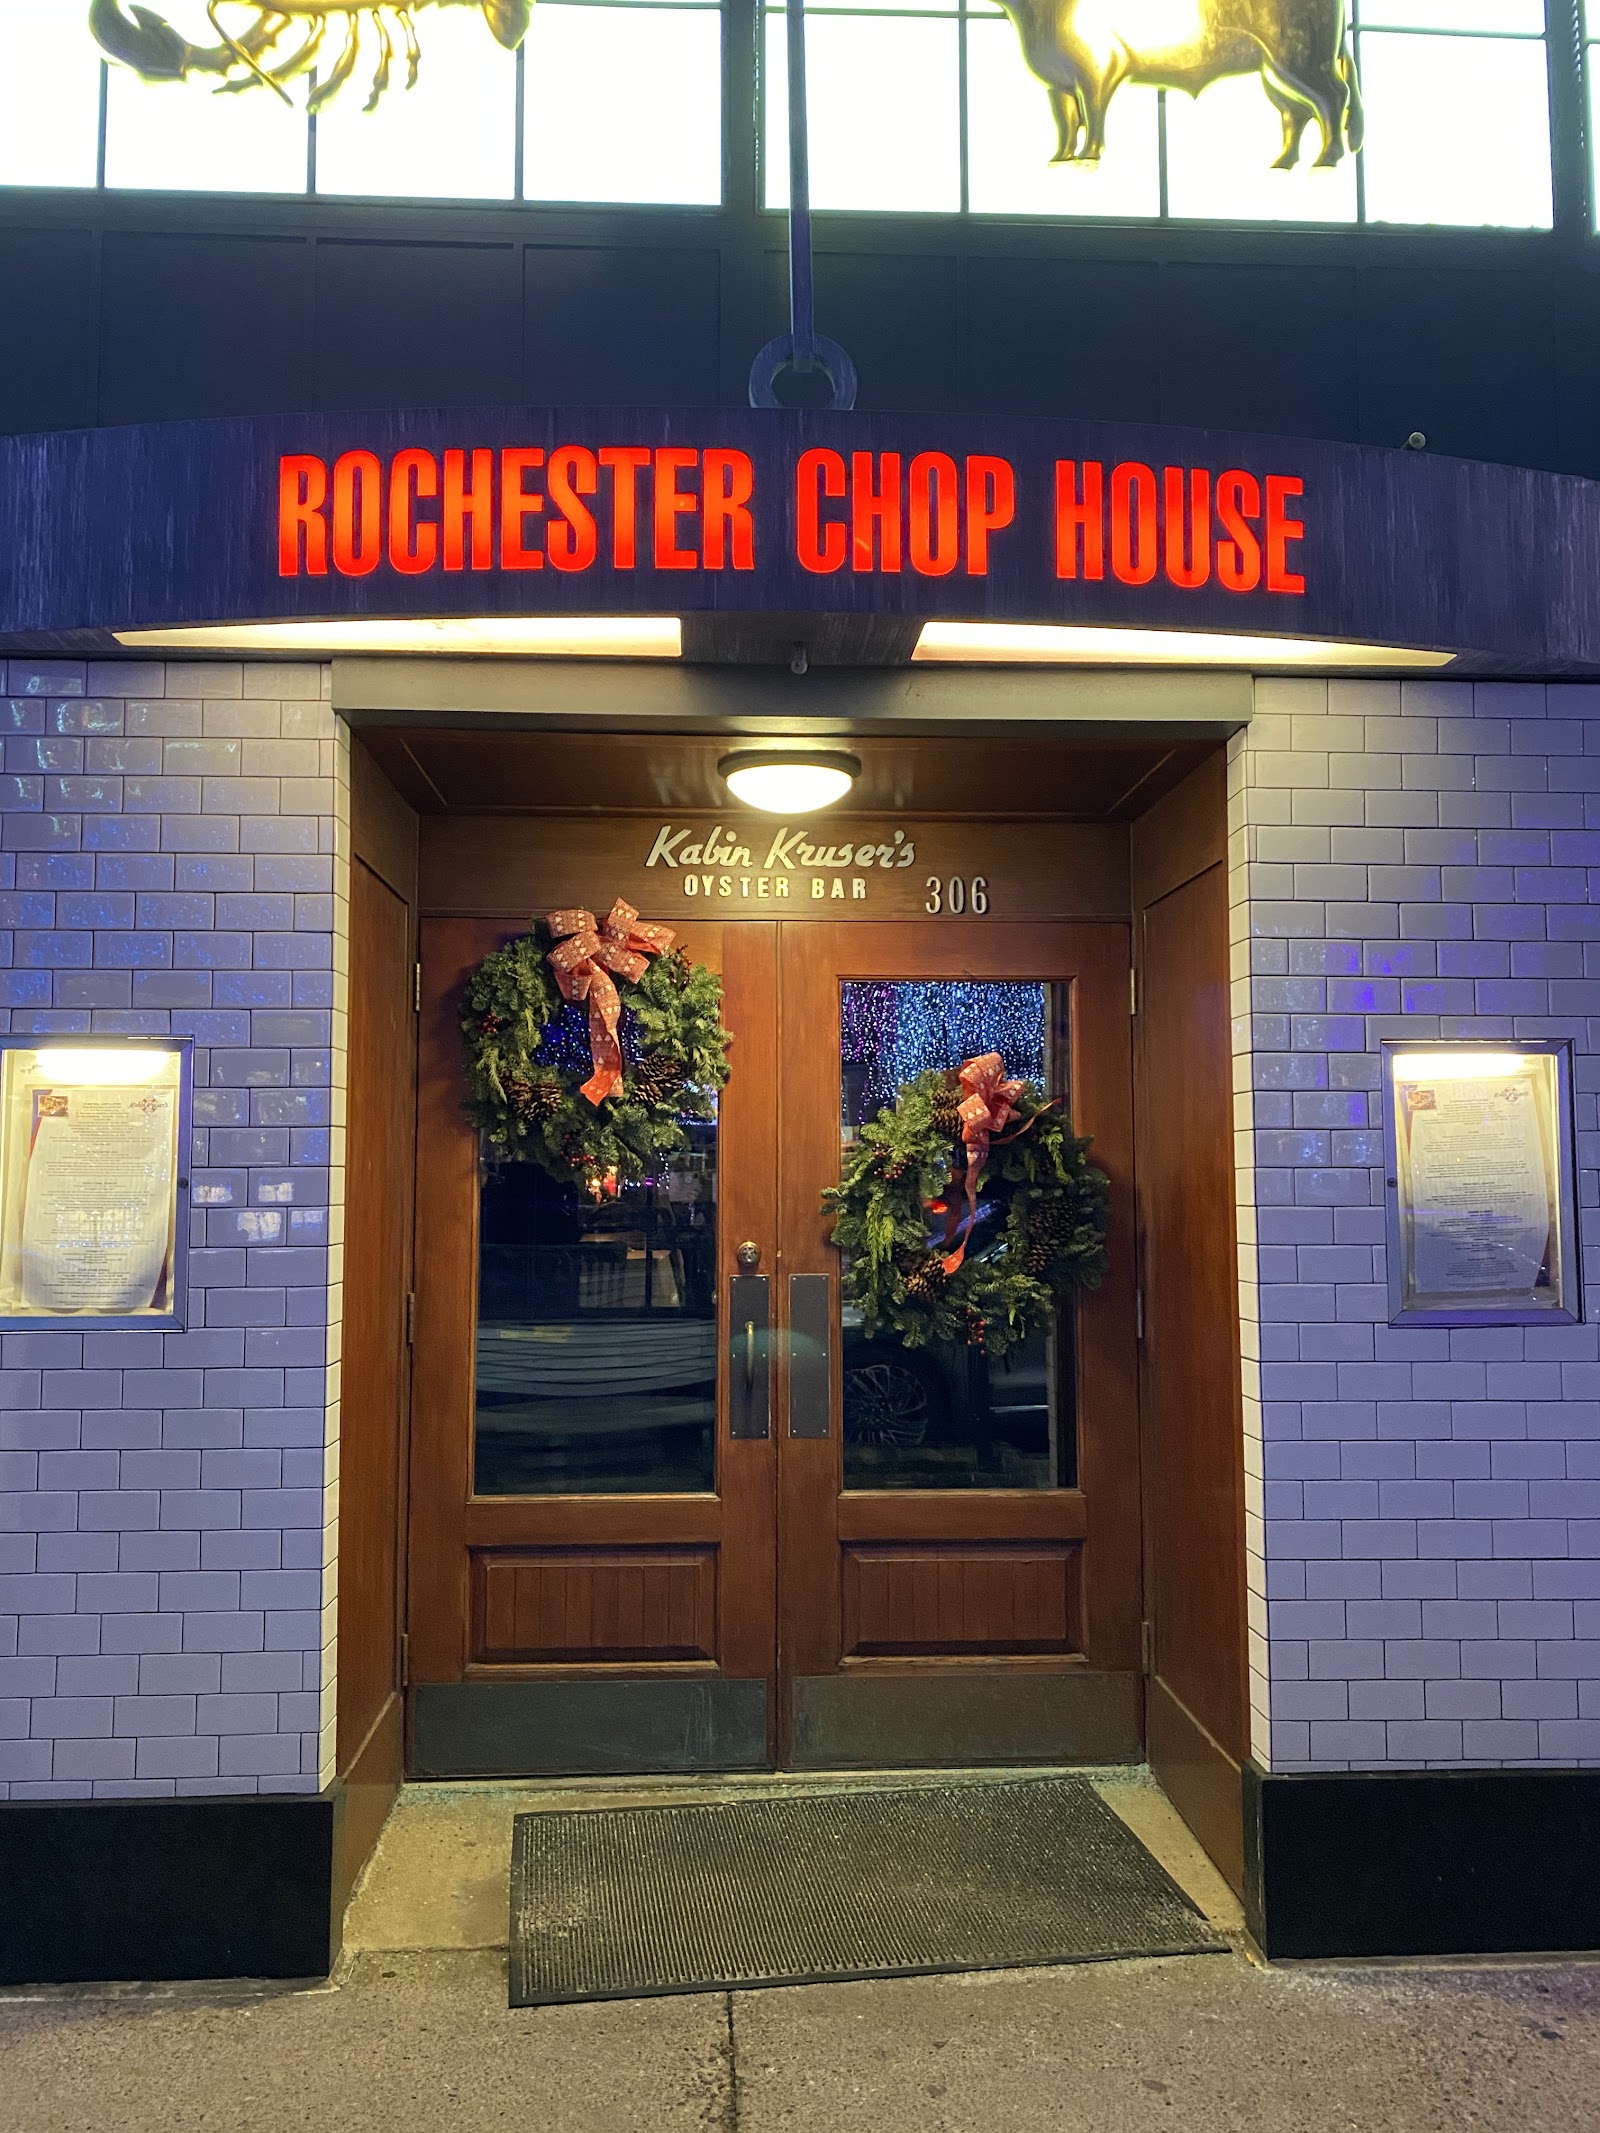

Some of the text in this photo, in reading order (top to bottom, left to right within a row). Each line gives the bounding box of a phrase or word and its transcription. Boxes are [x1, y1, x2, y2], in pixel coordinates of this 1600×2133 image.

[278, 445, 1306, 594] ROCHESTER CHOP HOUSE
[645, 825, 915, 869] Kabin Kruser's
[684, 874, 867, 899] OYSTER BAR
[925, 875, 988, 914] 306
